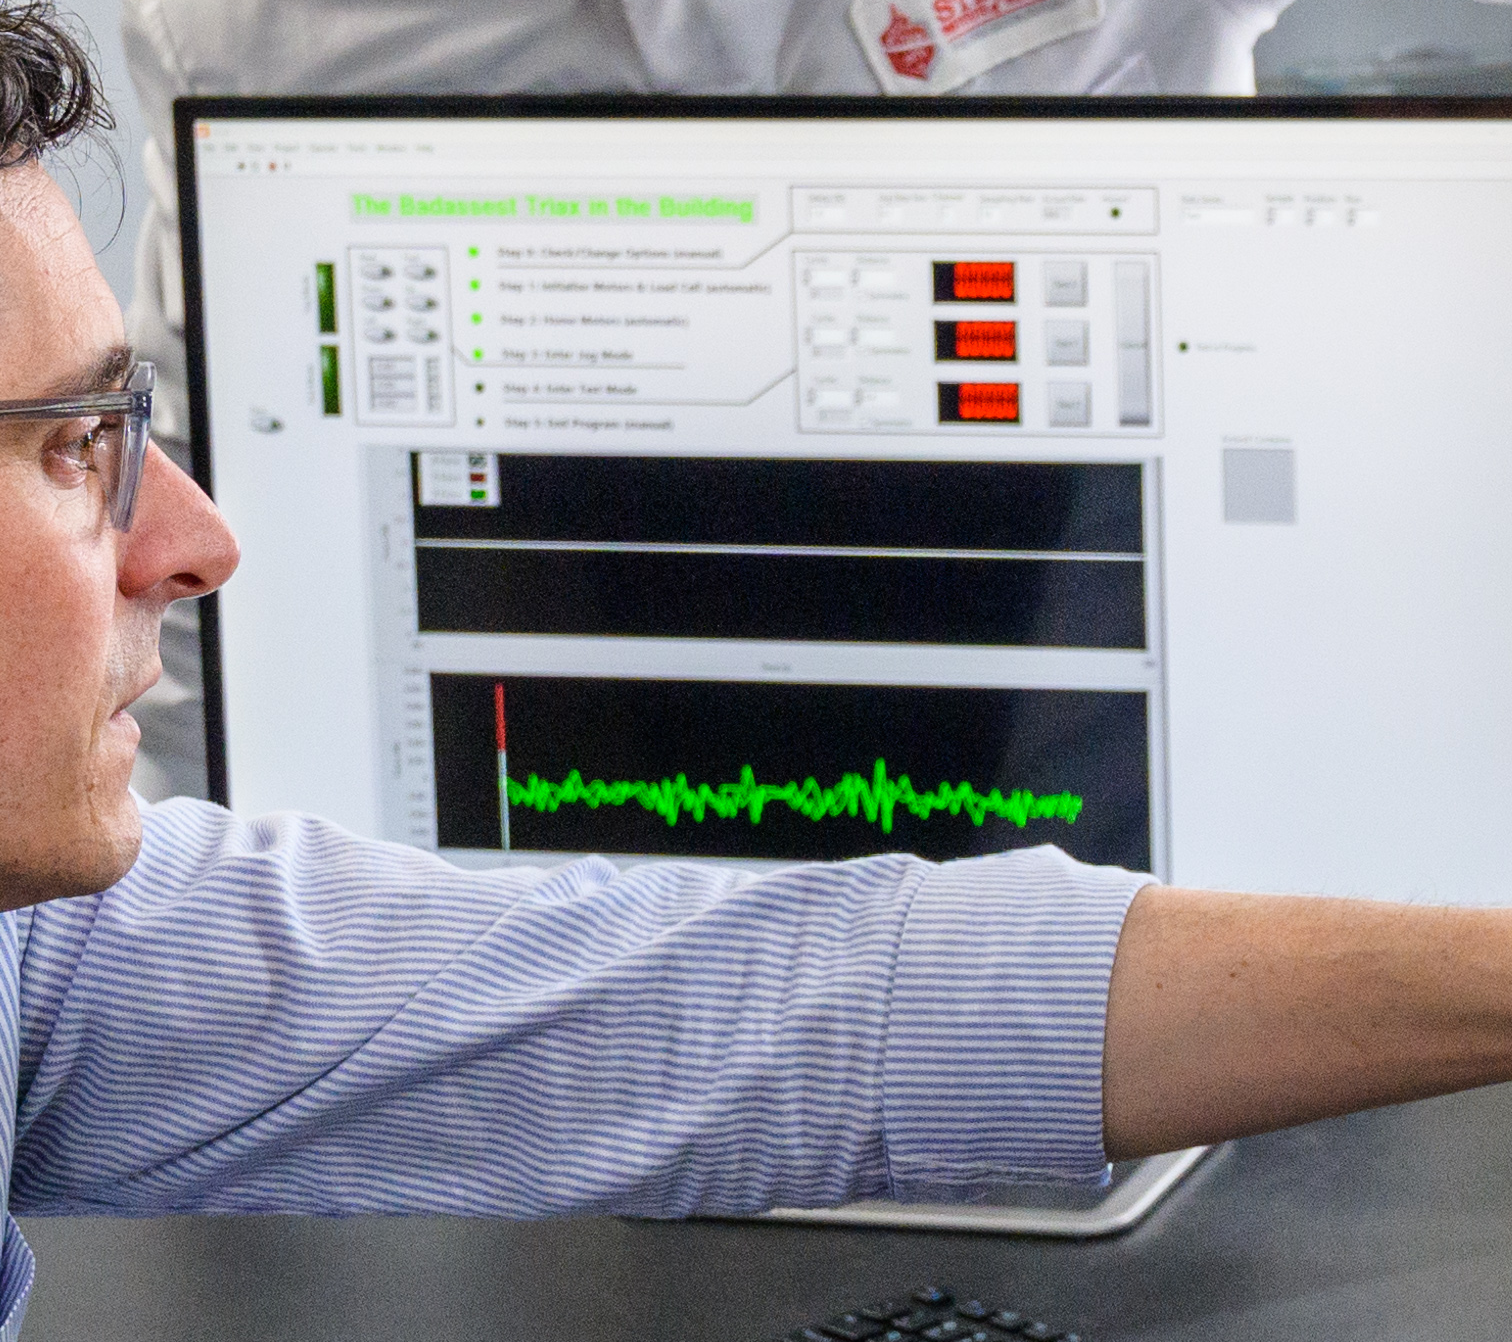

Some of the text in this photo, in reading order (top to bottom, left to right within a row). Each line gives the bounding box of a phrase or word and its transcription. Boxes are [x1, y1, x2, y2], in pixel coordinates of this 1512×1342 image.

[351, 193, 754, 223] The Badassest Triax in the Building
